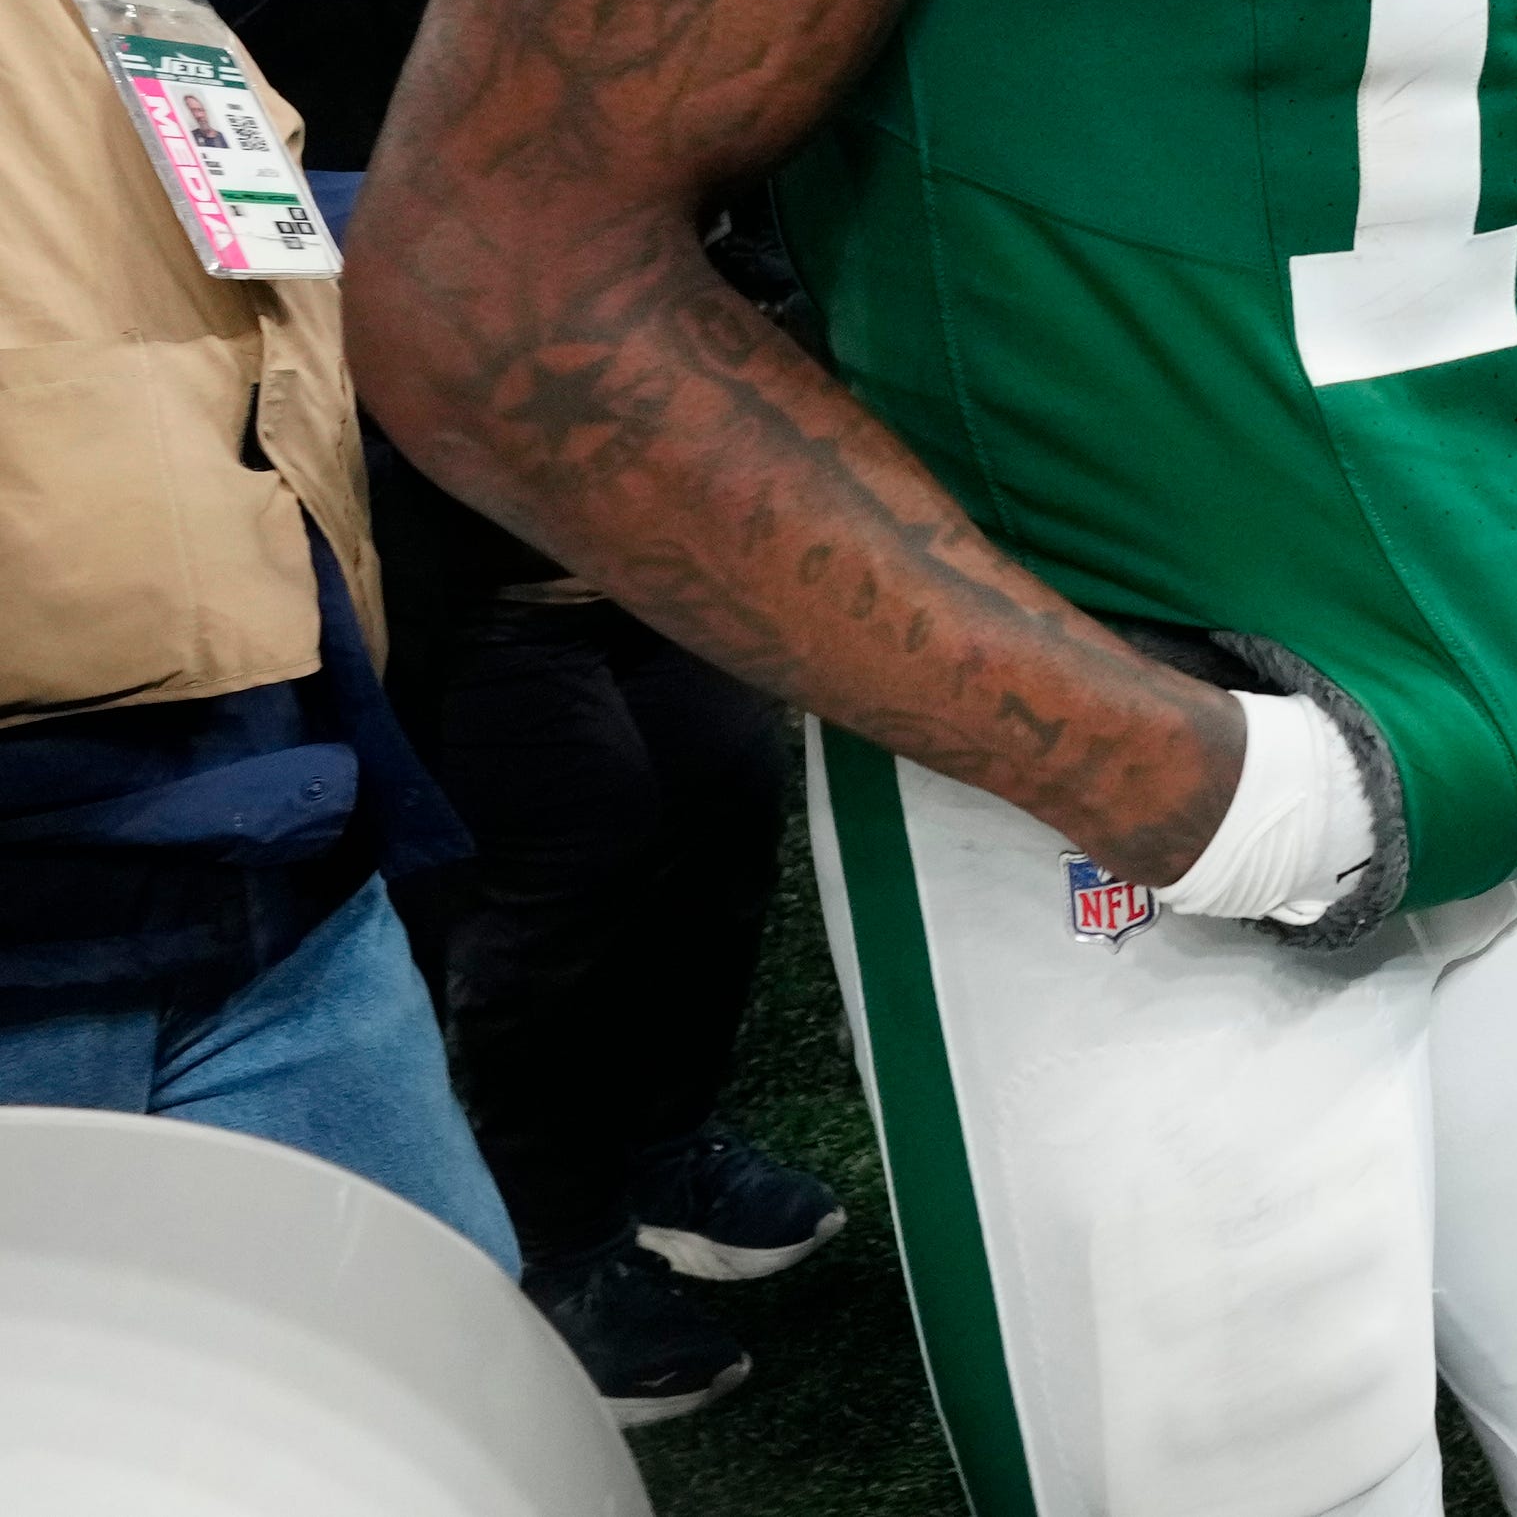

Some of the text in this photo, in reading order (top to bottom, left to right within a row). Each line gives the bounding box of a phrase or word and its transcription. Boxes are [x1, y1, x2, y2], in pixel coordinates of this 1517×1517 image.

[154, 52, 214, 78] JETS
[145, 96, 234, 251] MEDIA
[1079, 883, 1145, 929] NFL
